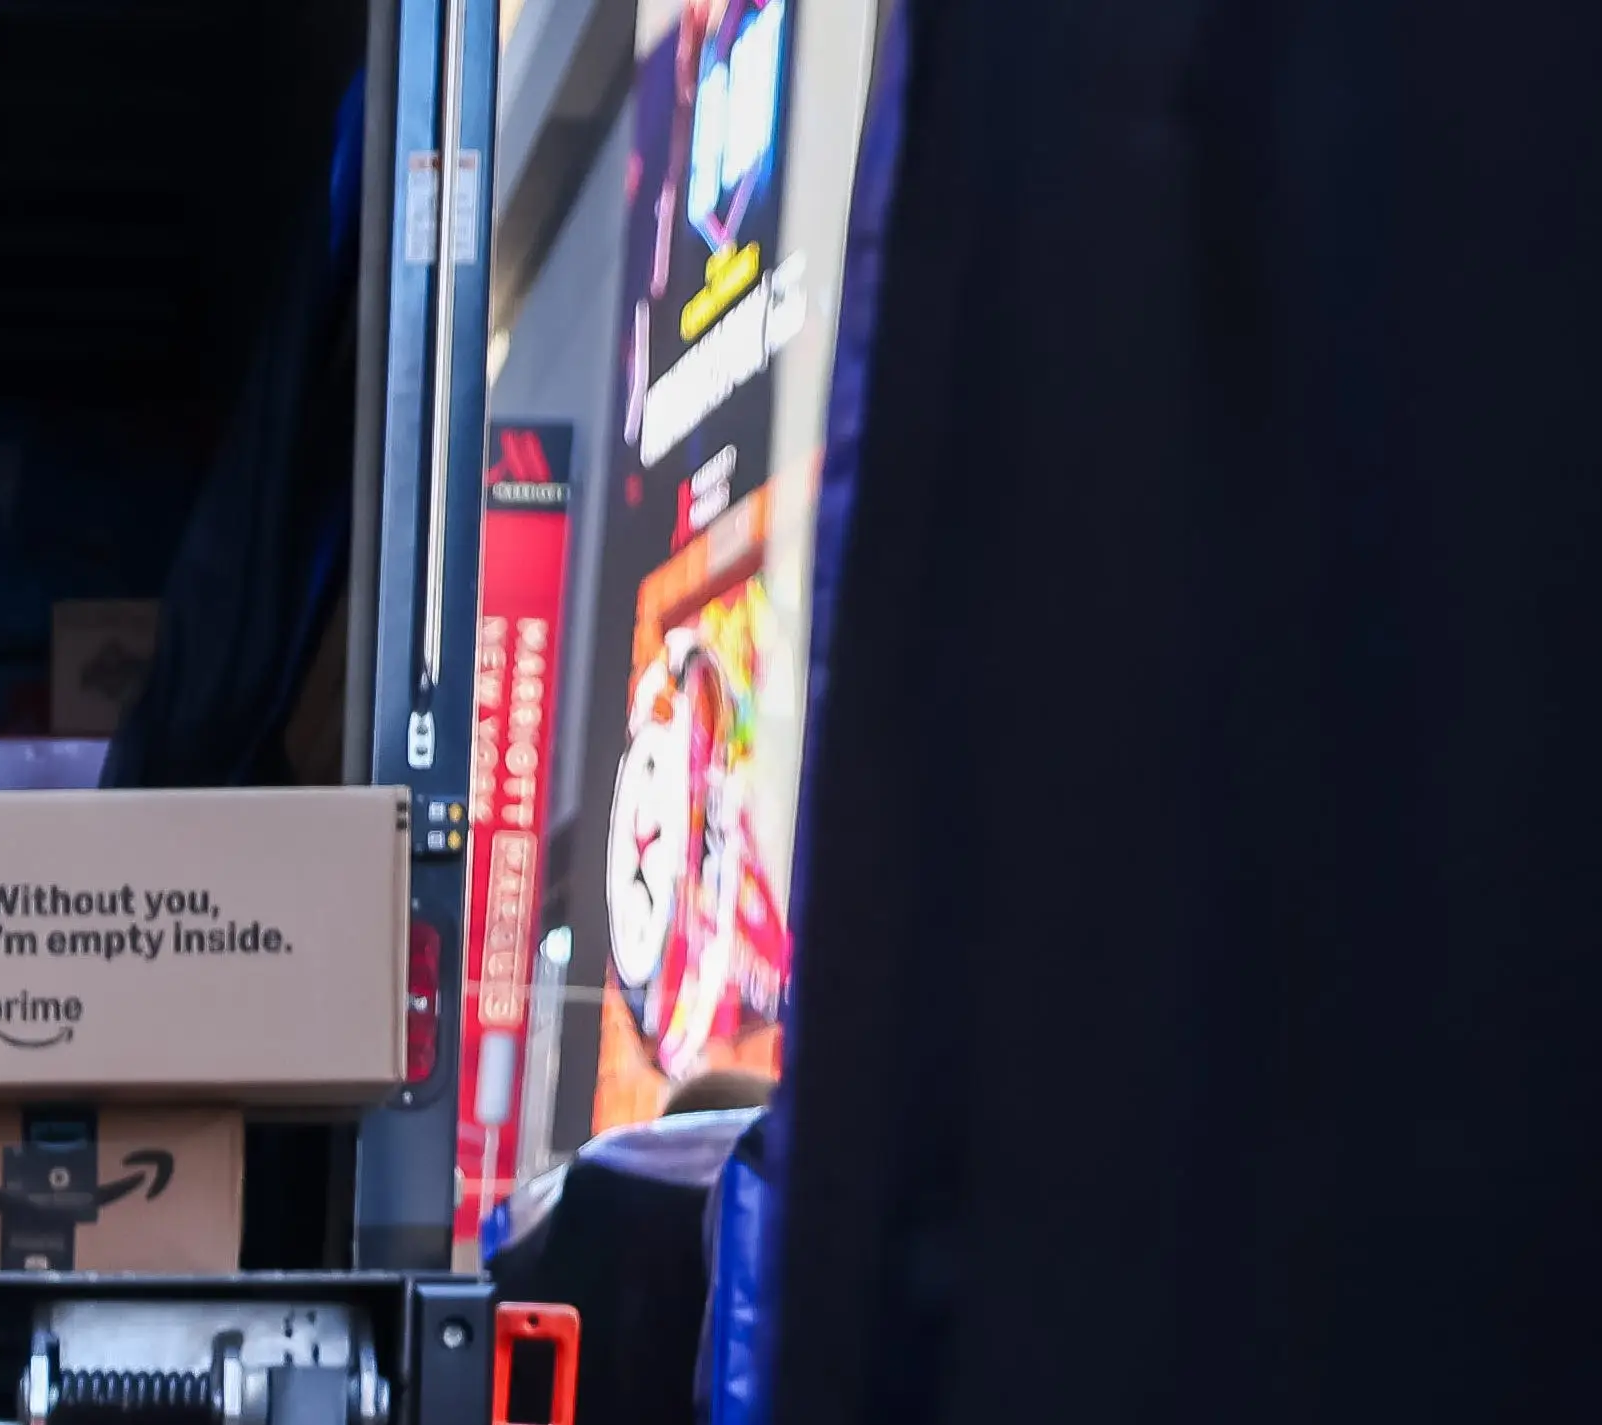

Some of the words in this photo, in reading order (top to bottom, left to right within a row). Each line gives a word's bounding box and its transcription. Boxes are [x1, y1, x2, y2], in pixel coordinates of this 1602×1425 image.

[143, 888, 219, 921] you,
[45, 922, 165, 961] empty
[172, 920, 293, 955] inside.
